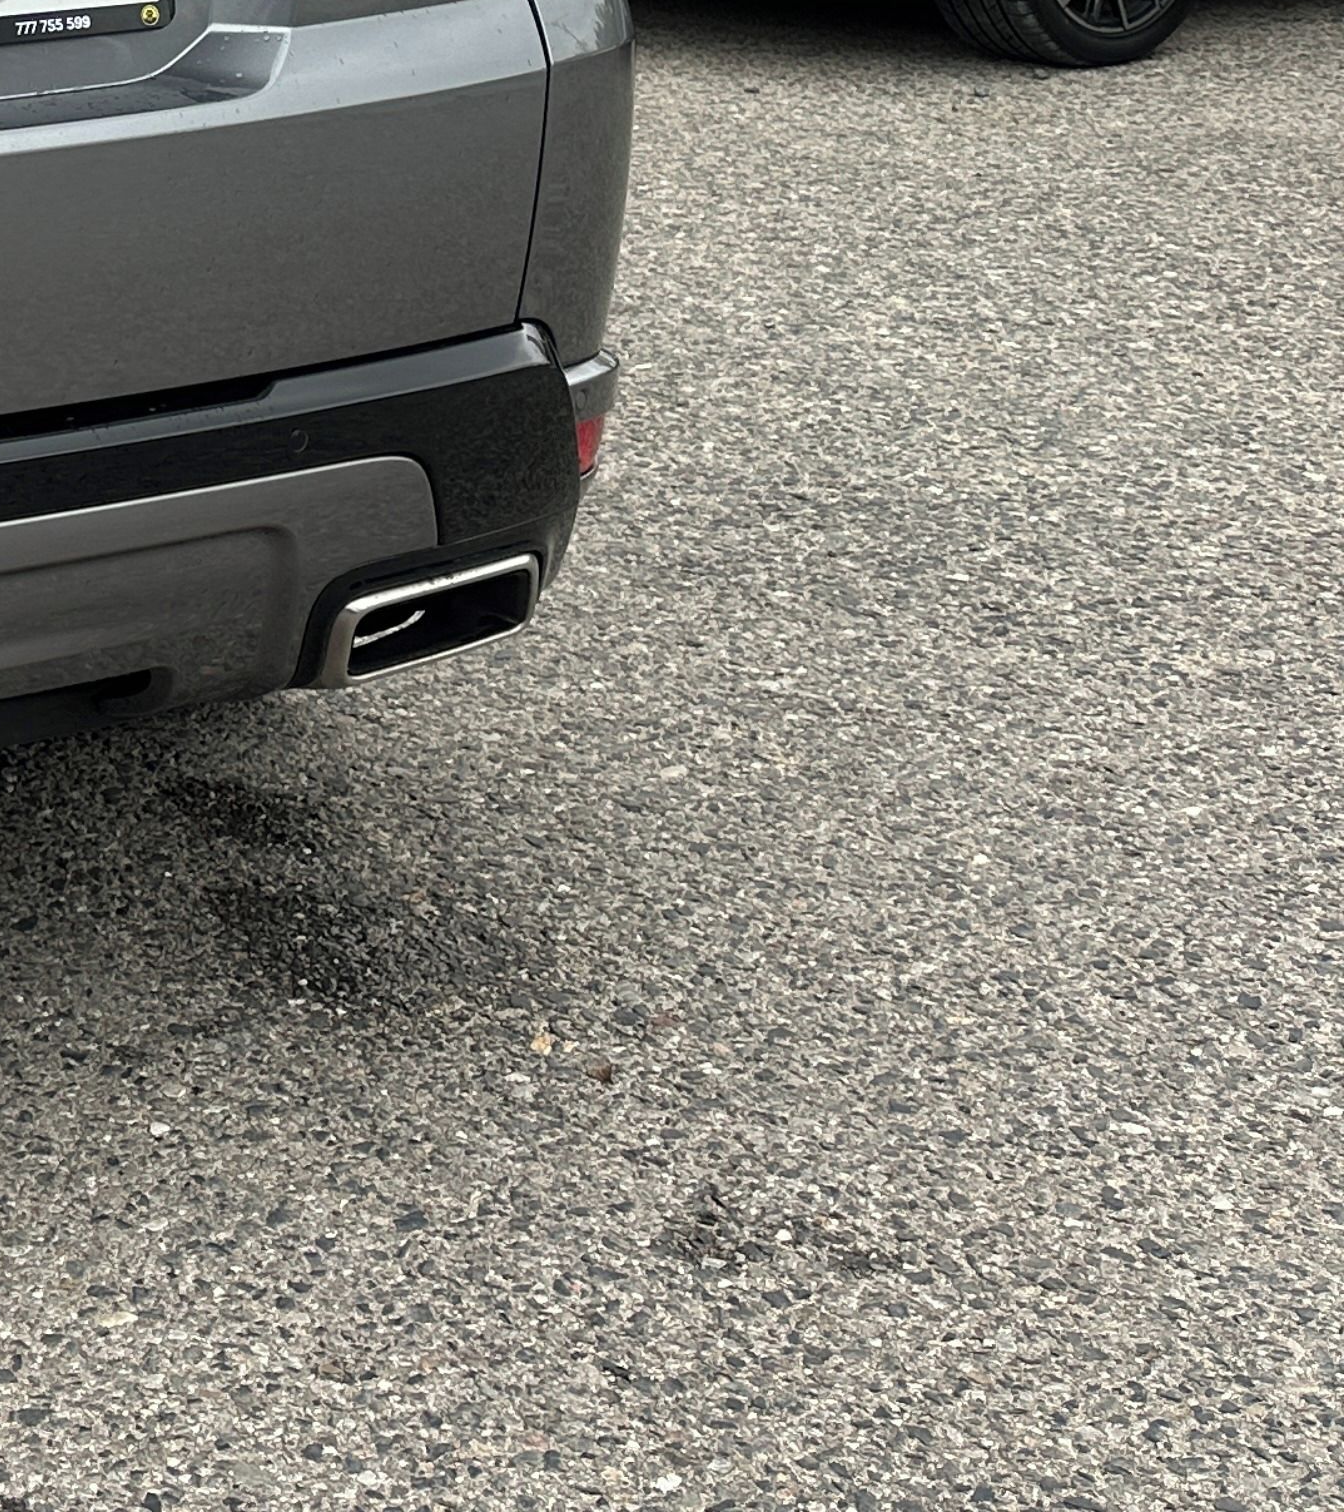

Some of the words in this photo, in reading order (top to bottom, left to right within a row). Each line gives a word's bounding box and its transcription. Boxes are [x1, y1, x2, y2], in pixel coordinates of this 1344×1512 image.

[15, 19, 37, 35] 777
[39, 18, 63, 32] 755
[66, 15, 92, 30] 599
